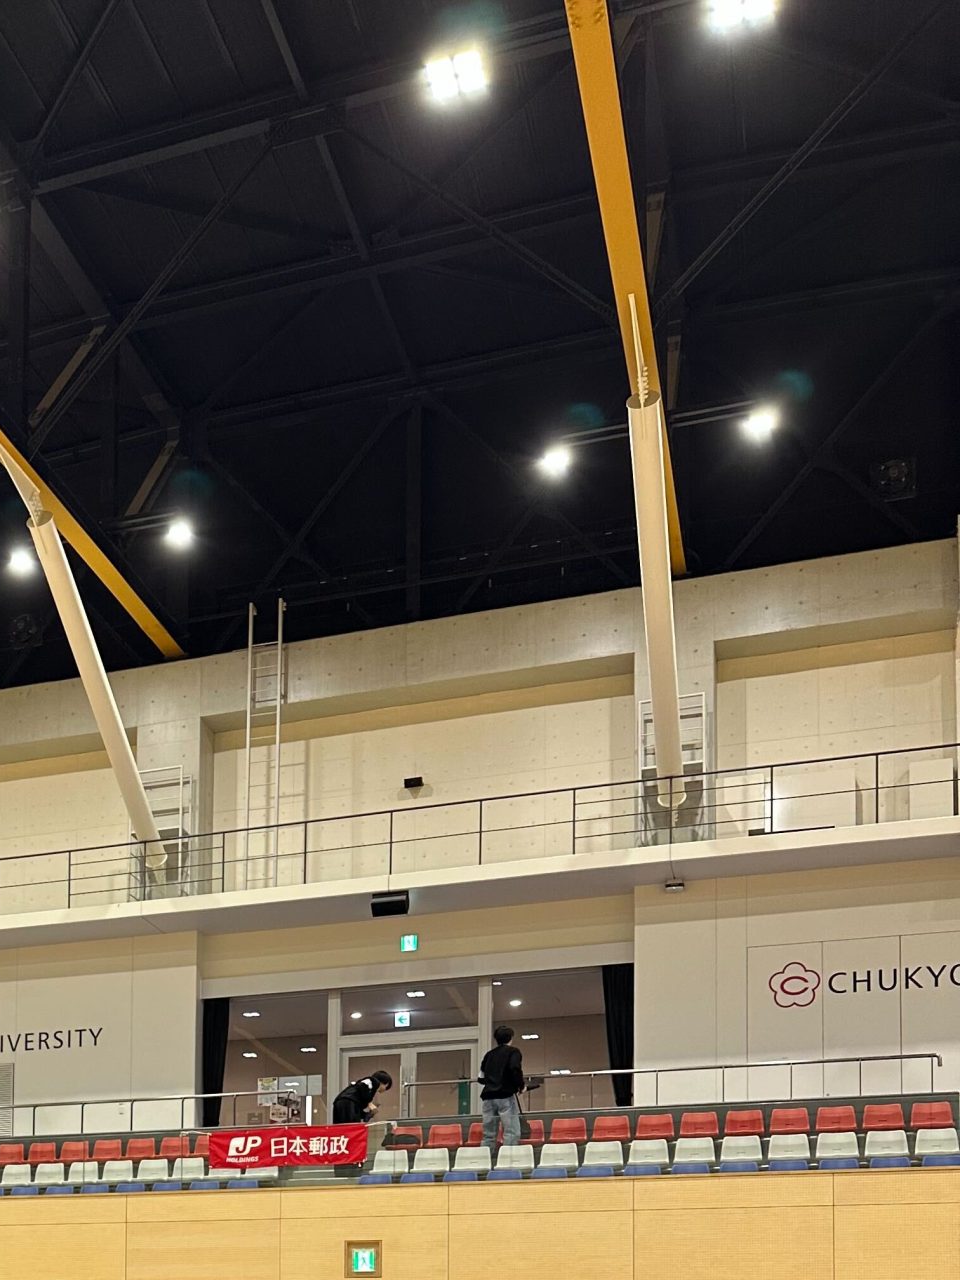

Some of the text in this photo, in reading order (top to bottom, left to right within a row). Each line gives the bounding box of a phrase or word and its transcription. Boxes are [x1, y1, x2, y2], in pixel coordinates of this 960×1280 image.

[228, 1136, 262, 1156] JP
[270, 1136, 350, 1157] 日本郵政
